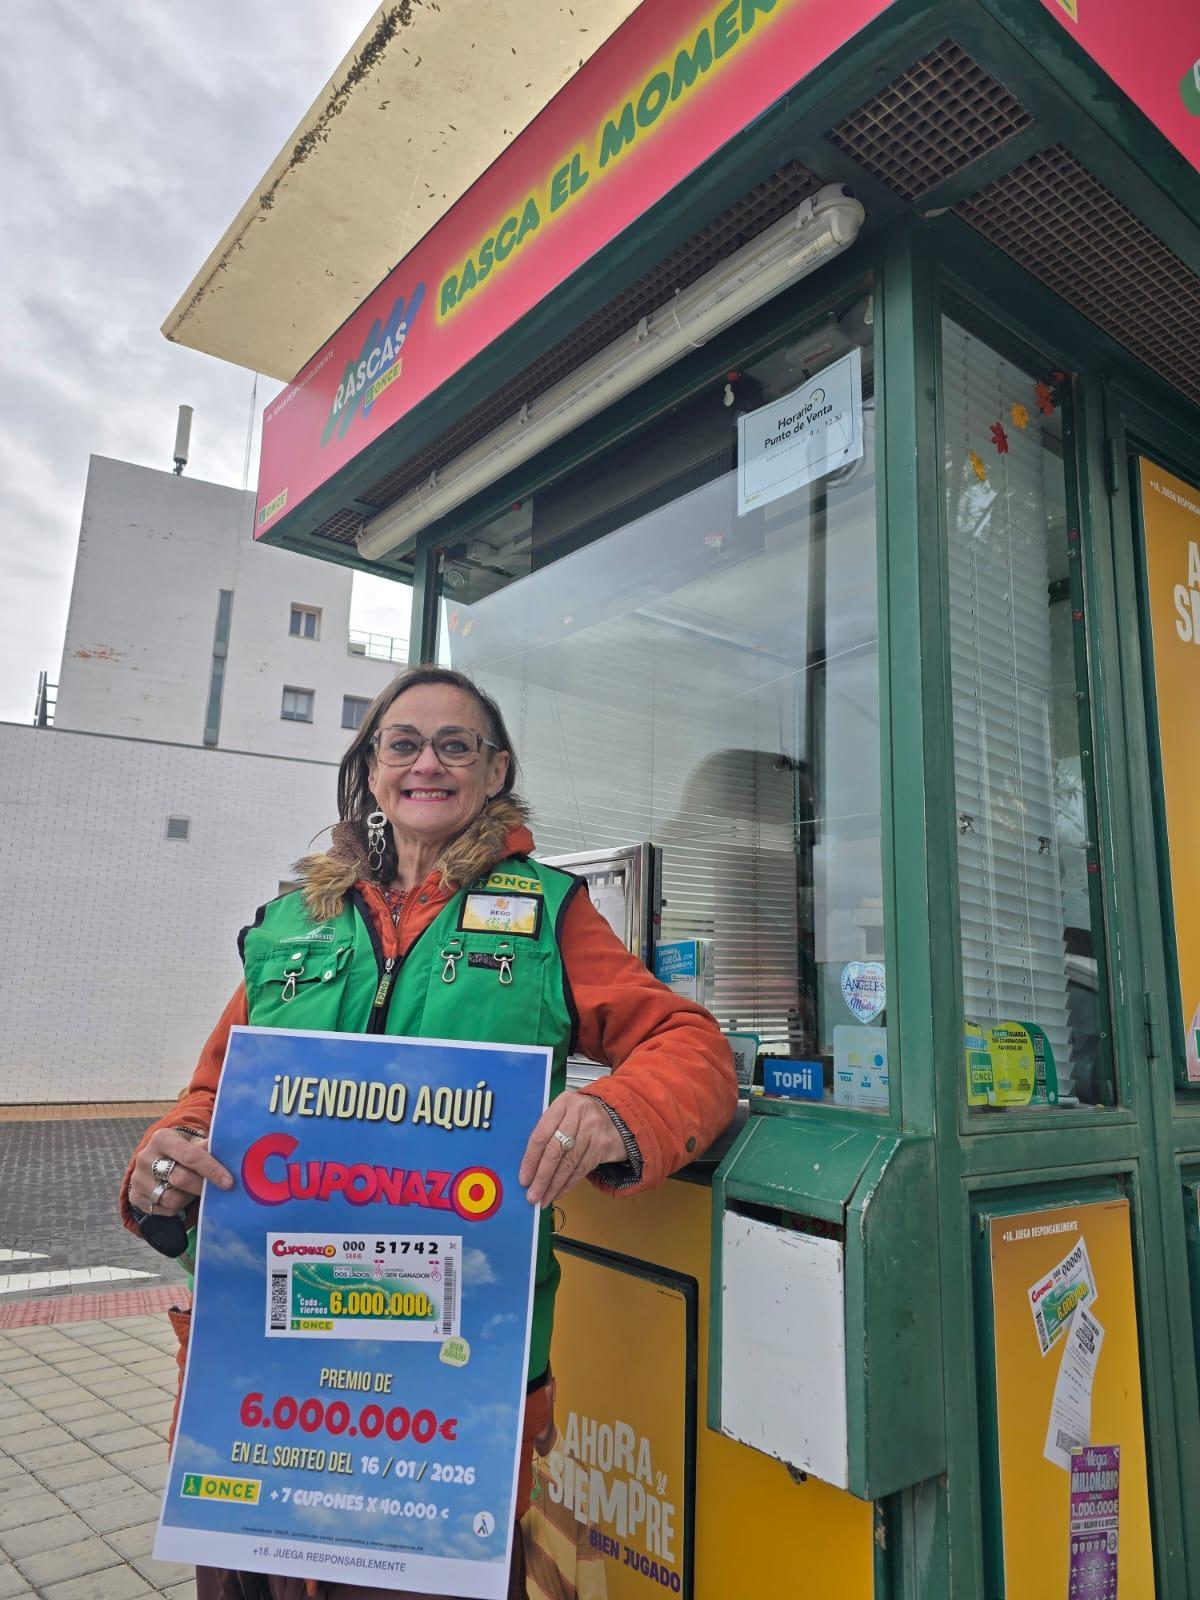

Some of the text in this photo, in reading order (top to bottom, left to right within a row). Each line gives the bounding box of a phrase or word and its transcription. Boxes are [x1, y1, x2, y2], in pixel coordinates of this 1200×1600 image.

[440, 198, 540, 316] RASCA
[550, 153, 590, 214] EL
[333, 322, 407, 415] RASCAS
[373, 363, 400, 393] ONCE
[764, 430, 792, 448] Punto
[793, 421, 805, 434] de
[806, 404, 833, 424] Venta
[778, 403, 813, 430] Horario
[265, 493, 286, 516] ONCE
[491, 875, 540, 891] ONCE
[268, 1075, 493, 1129] ¡VENDIDO AQUÍ!
[242, 1132, 503, 1222] CUPONAZO
[1015, 1228, 1031, 1240] JUEGA
[1031, 1220, 1078, 1238] RESPONSABLEMENTE
[272, 1239, 337, 1258] CUPONAZO
[342, 1240, 366, 1251] 000
[375, 1241, 439, 1255] 51742
[329, 1291, 433, 1317] 6.000.000€
[302, 1321, 331, 1330] ONCE
[320, 1368, 393, 1393] PREMIO DE
[239, 1392, 458, 1444] 6.000.000€
[564, 1411, 653, 1486] AHORA
[231, 1441, 249, 1464] EN
[252, 1443, 269, 1466] EL
[272, 1445, 325, 1471] SORTEO
[328, 1452, 353, 1474] DEL
[360, 1455, 380, 1475] 16
[430, 1463, 475, 1485] 2026
[205, 1480, 256, 1500] ONCE
[1072, 1470, 1118, 1493] MILLONARIO
[293, 1489, 364, 1512] CUPONES
[548, 1450, 675, 1563] SIEMPRE
[253, 1547, 407, 1572] +18. JUEGA RESPONSABLEMENTE
[589, 1529, 681, 1593] BIEN JUGADO
